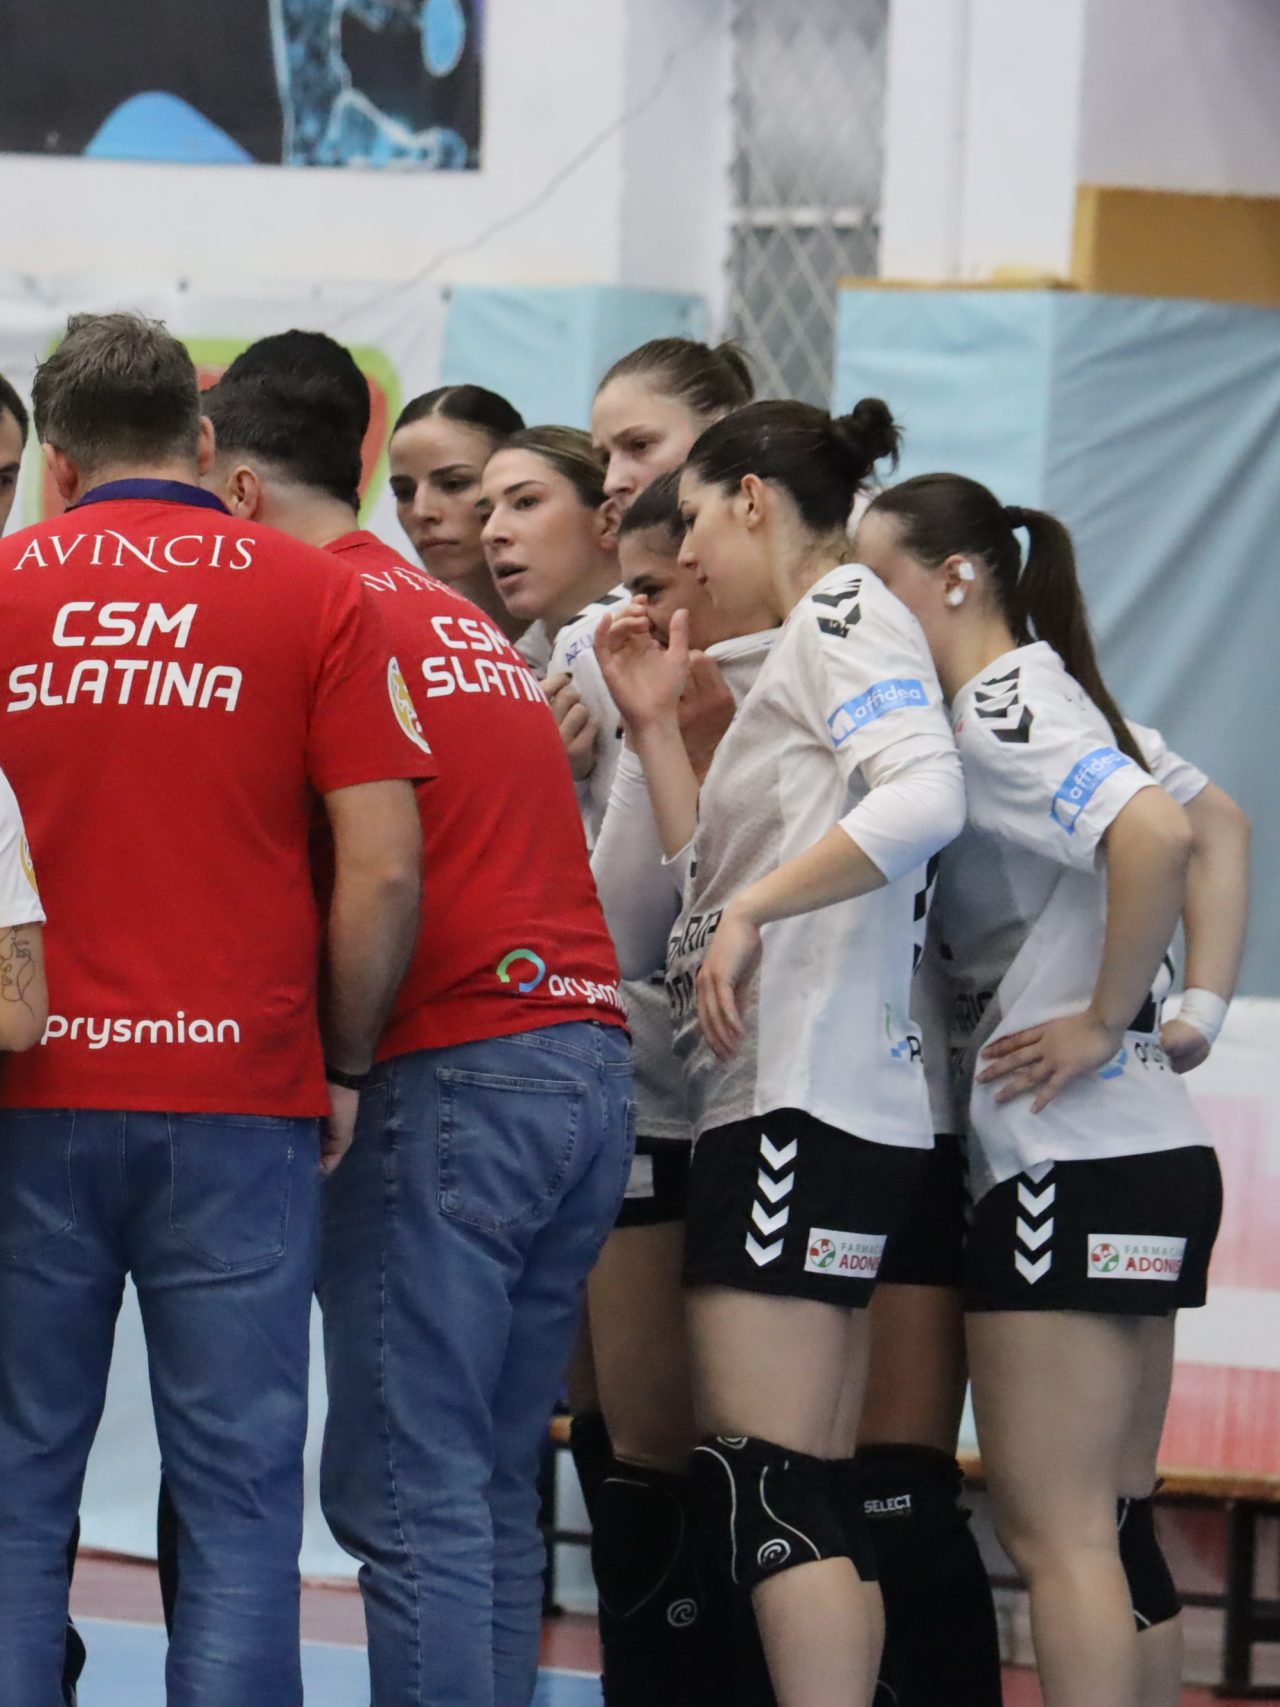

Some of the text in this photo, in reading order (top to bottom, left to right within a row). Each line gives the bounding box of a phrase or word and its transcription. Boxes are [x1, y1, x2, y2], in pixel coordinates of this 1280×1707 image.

[13, 529, 256, 573] AVINCIS
[52, 601, 198, 648] CSM
[431, 616, 520, 660] CSM
[7, 659, 243, 713] SLATINA
[422, 656, 550, 706] SLATIN
[40, 1010, 240, 1050] prysmian
[864, 1495, 911, 1513] SELECT
